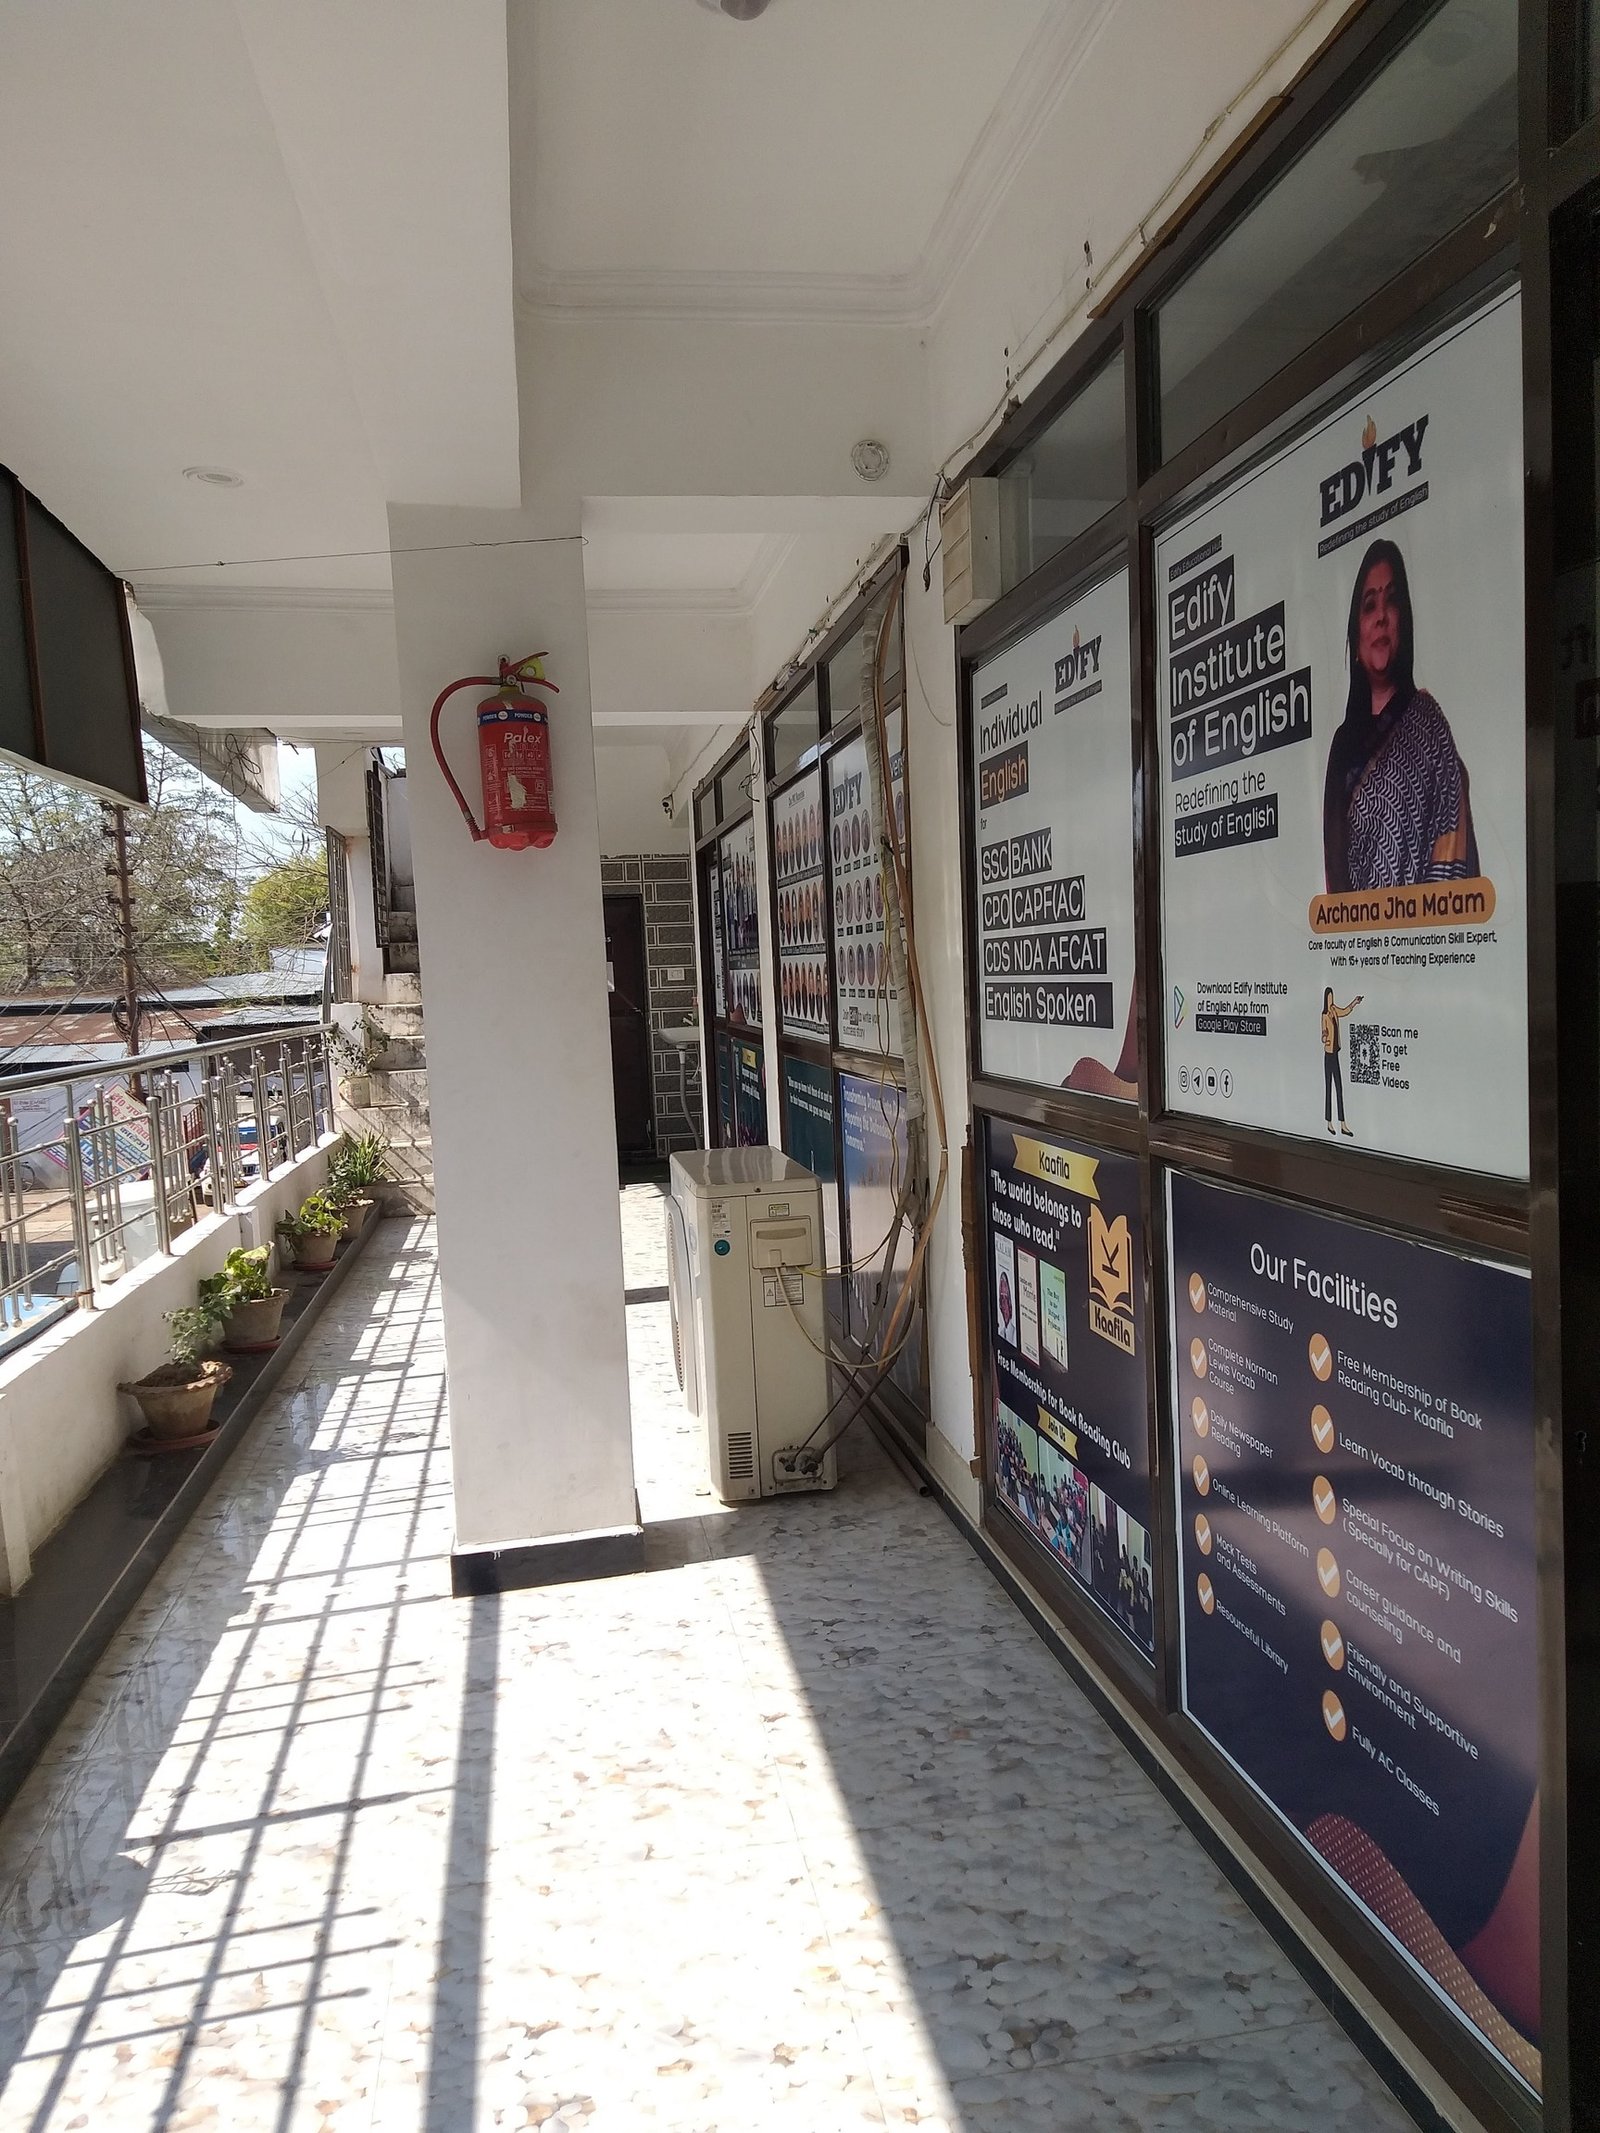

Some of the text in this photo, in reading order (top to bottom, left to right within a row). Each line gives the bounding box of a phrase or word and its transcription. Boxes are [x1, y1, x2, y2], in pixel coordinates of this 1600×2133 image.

[1320, 414, 1429, 528] EDIFY
[1172, 574, 1233, 641] Edify
[1054, 635, 1102, 694] EDIFY
[1172, 624, 1285, 707] Institute
[980, 690, 1043, 755] Individual
[1173, 679, 1309, 767] of English
[981, 755, 1028, 801] English
[1175, 771, 1266, 814] Redefining the
[1175, 804, 1275, 846] study of English
[983, 833, 1052, 881] SSC BANK
[984, 879, 1085, 927] CPO CAPF(AC)
[1316, 890, 1485, 925] Archana Jha Ma'am
[985, 933, 1105, 972] CDS NDA AFCAT
[1308, 940, 1323, 951] Core
[1324, 937, 1347, 951] faculty
[1348, 938, 1355, 948] of
[1357, 936, 1383, 950] English
[1384, 937, 1390, 946] &
[1391, 933, 1447, 947] Comunication
[1448, 931, 1465, 944] Skill
[1330, 952, 1476, 968] With 15+ years of Teaching Experience
[986, 986, 1097, 1024] English Spoken
[1197, 981, 1288, 997] Download Edify Institute
[1197, 1000, 1269, 1016] of English App from
[1198, 1018, 1261, 1034] Google Play Store
[1381, 1026, 1419, 1039] Scan me
[1381, 1043, 1408, 1056] To get
[1382, 1060, 1401, 1072] Free
[1382, 1077, 1410, 1090] Videos
[1038, 1150, 1070, 1180] Kaafila
[990, 1169, 1082, 1229] "The world belongs to
[991, 1202, 1012, 1229] those
[1013, 1214, 1031, 1239] who
[1032, 1227, 1060, 1252] read."
[1207, 1282, 1295, 1334] Comprehensive Study
[1250, 1242, 1399, 1329] Our Facilities
[1094, 1307, 1132, 1347] Kaafila
[1208, 1300, 1237, 1323] Material
[1208, 1338, 1278, 1386] Complete Norman
[1208, 1356, 1256, 1391] Lewis Vocab
[1209, 1372, 1235, 1395] Course
[997, 1349, 1010, 1372] Free
[1010, 1359, 1047, 1404] Membership
[1047, 1388, 1058, 1410] for
[1058, 1397, 1077, 1427] Book
[1078, 1412, 1111, 1458] Reading
[1112, 1440, 1131, 1469] Club
[1337, 1350, 1483, 1431] Free Membership of Book
[1337, 1370, 1454, 1439] Reading Club- Kaafila
[1047, 1417, 1058, 1436] Join
[1210, 1410, 1273, 1458] Daily Newspaper
[1211, 1427, 1241, 1458] Reading
[1339, 1432, 1504, 1538] Learn Vocab through Stories
[1212, 1478, 1310, 1558] Online Learning Platform
[1216, 1533, 1258, 1575] Mock Tests
[1342, 1498, 1519, 1624] Special Focus on Writing Skills
[1396, 1551, 1411, 1573] for
[1414, 1565, 1450, 1602] CAPF)
[1216, 1552, 1287, 1616] and Assessments
[1216, 1599, 1289, 1675] Resourceful Library
[1346, 1569, 1461, 1664] Career guidance and
[1346, 1591, 1403, 1645] counseling
[1347, 1661, 1417, 1730] Environment
[1347, 1641, 1479, 1760] Friendly and Supportive
[1352, 1726, 1440, 1816] Fully AC Classes
